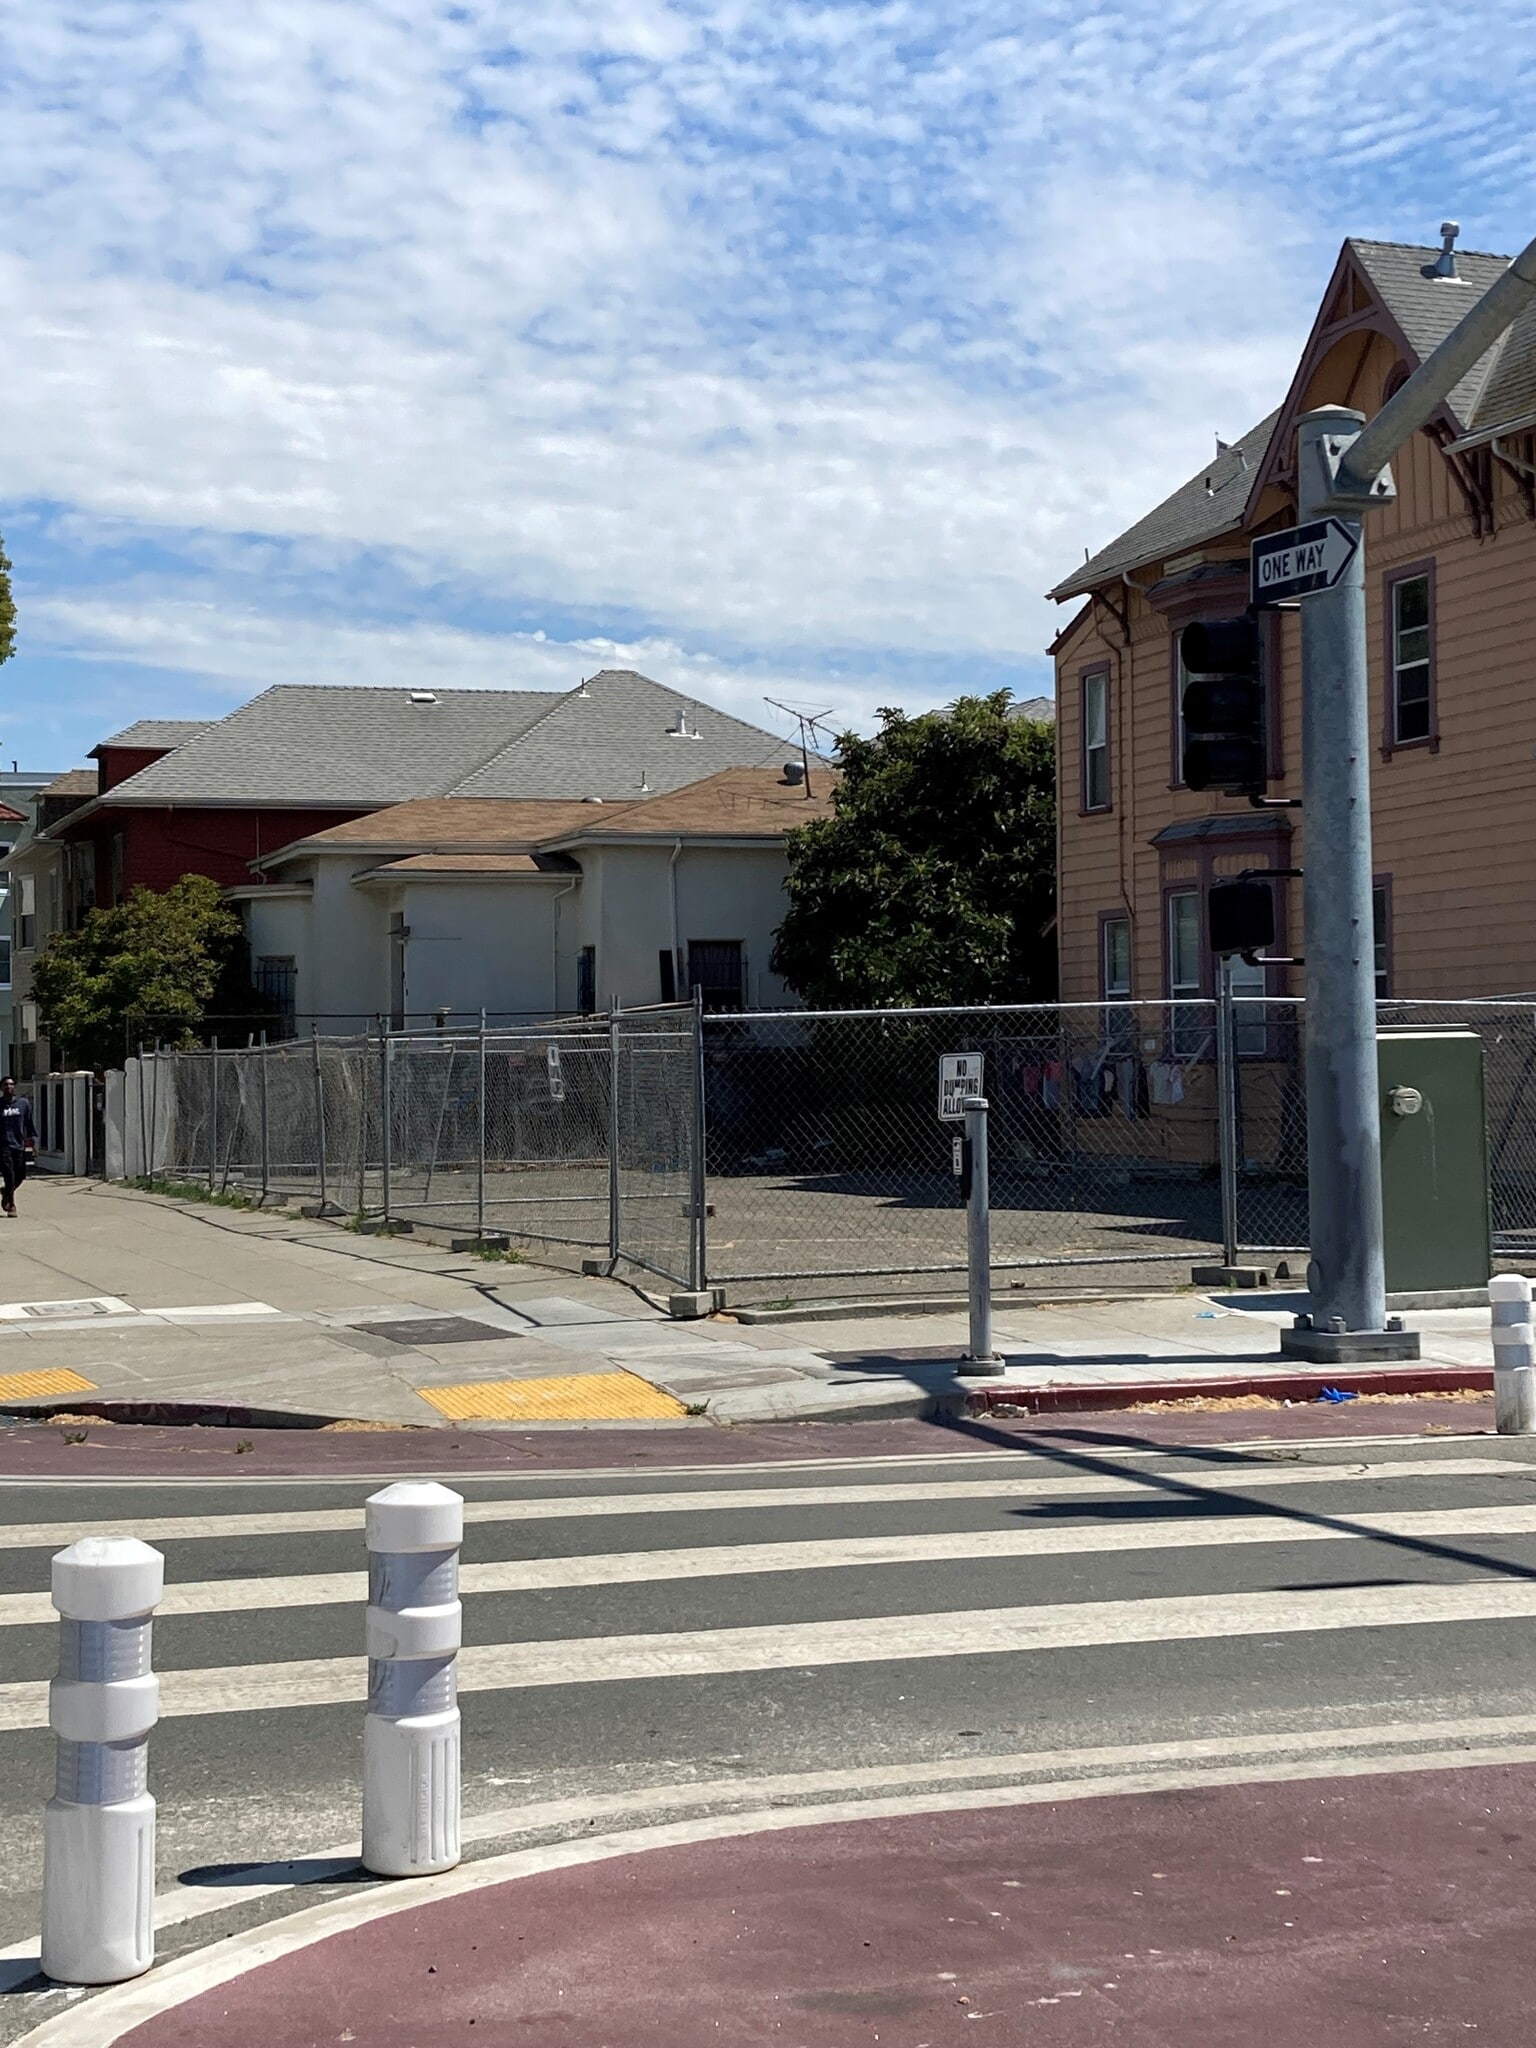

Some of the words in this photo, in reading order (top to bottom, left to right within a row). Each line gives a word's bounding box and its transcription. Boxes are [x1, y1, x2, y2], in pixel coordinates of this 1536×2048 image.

[1262, 552, 1290, 582] ONE
[1295, 543, 1325, 573] WAY
[956, 1059, 968, 1077] NO
[943, 1077, 979, 1096] DUMPING
